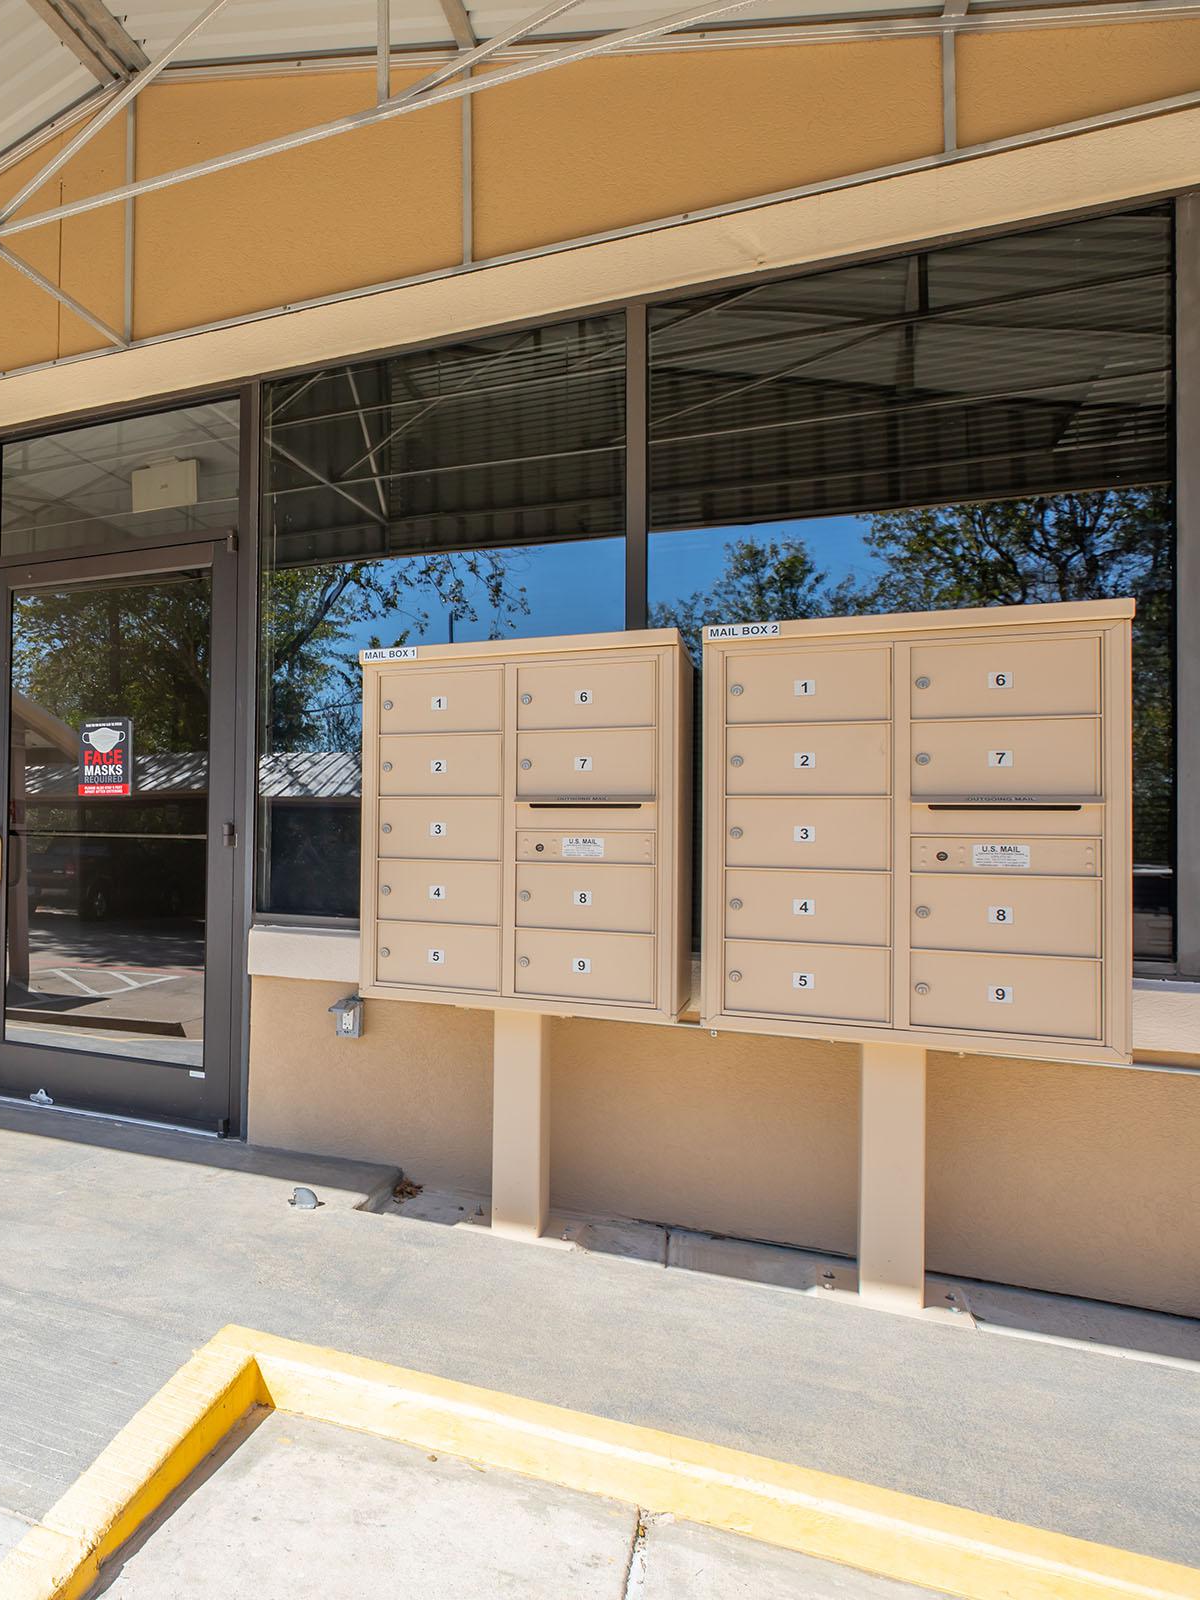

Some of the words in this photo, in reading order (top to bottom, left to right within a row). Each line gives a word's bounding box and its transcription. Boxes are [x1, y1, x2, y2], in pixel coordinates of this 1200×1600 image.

[709, 627, 739, 638] MAIL
[742, 625, 768, 635] BOX
[771, 625, 779, 634] 2
[364, 650, 387, 659] MAIL
[389, 649, 409, 659] BOX
[410, 649, 416, 657] 1
[995, 673, 1006, 687] 6
[801, 682, 808, 694] 1
[436, 698, 442, 708] 1
[580, 691, 588, 703] 6
[84, 749, 123, 766] FACE
[579, 758, 587, 769] 7
[800, 754, 809, 767] 2
[995, 752, 1006, 765] 7
[84, 764, 123, 776] MASKS
[435, 761, 442, 772] 2
[84, 775, 123, 784] REQUIRED
[434, 824, 442, 835] 3
[800, 828, 809, 840] 3
[981, 845, 998, 853] U.S.
[1000, 845, 1021, 853] MAIL
[433, 887, 441, 898] 4
[579, 892, 587, 904] 8
[799, 901, 809, 913] 4
[996, 909, 1006, 922] 8
[432, 951, 440, 962] 5
[577, 960, 586, 971] 9
[798, 975, 808, 987] 5
[995, 988, 1006, 1001] 9
